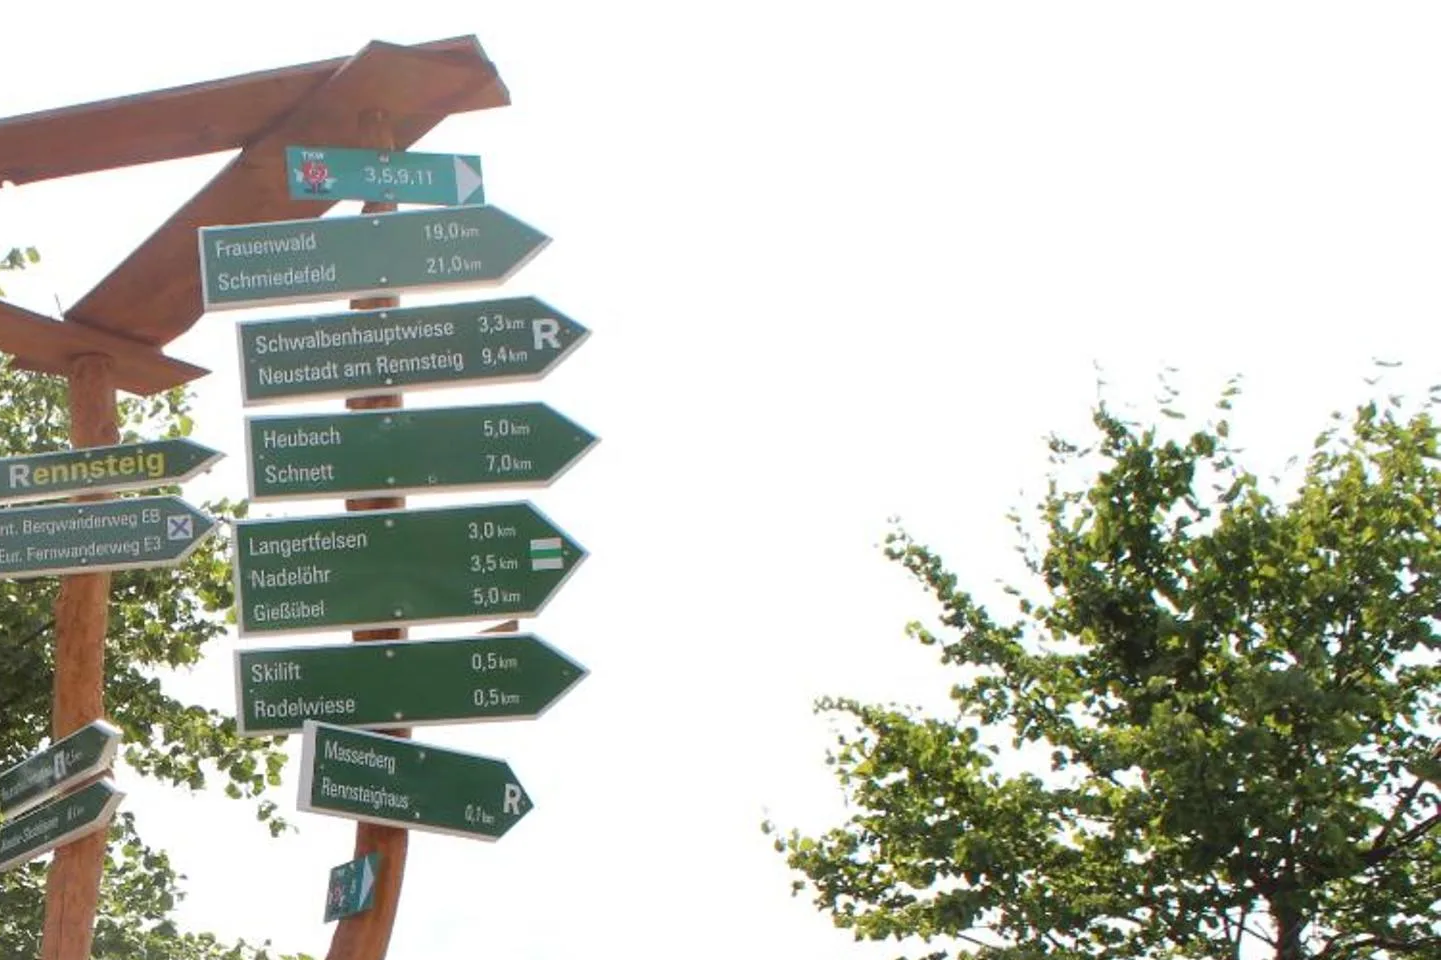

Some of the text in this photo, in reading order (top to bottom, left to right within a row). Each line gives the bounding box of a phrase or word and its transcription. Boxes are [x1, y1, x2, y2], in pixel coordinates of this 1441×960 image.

[216, 232, 317, 258] Frauenwald
[218, 265, 336, 292] Schmiedefeld
[255, 321, 454, 354] Schwalbenhauptwiese
[532, 318, 561, 350] R
[259, 356, 338, 385] Neustadt
[344, 361, 371, 378] am
[376, 350, 464, 376] Rennsteig
[263, 427, 341, 449] Heubach
[8, 447, 166, 490] Rennsteig
[264, 463, 335, 485] Schnett
[23, 511, 138, 536] Bergwanderweg
[26, 539, 140, 563] Fernwanderweg
[143, 536, 162, 552] E3
[249, 531, 368, 557] Langertfelsen
[251, 566, 331, 589] Nadelöhr
[253, 600, 325, 622] Gießübel
[251, 662, 302, 682] Skilift
[253, 697, 356, 720] Rodelwiese
[324, 740, 396, 774] Masserberg
[322, 777, 410, 811] Rennsteighaus
[503, 783, 521, 815] R
